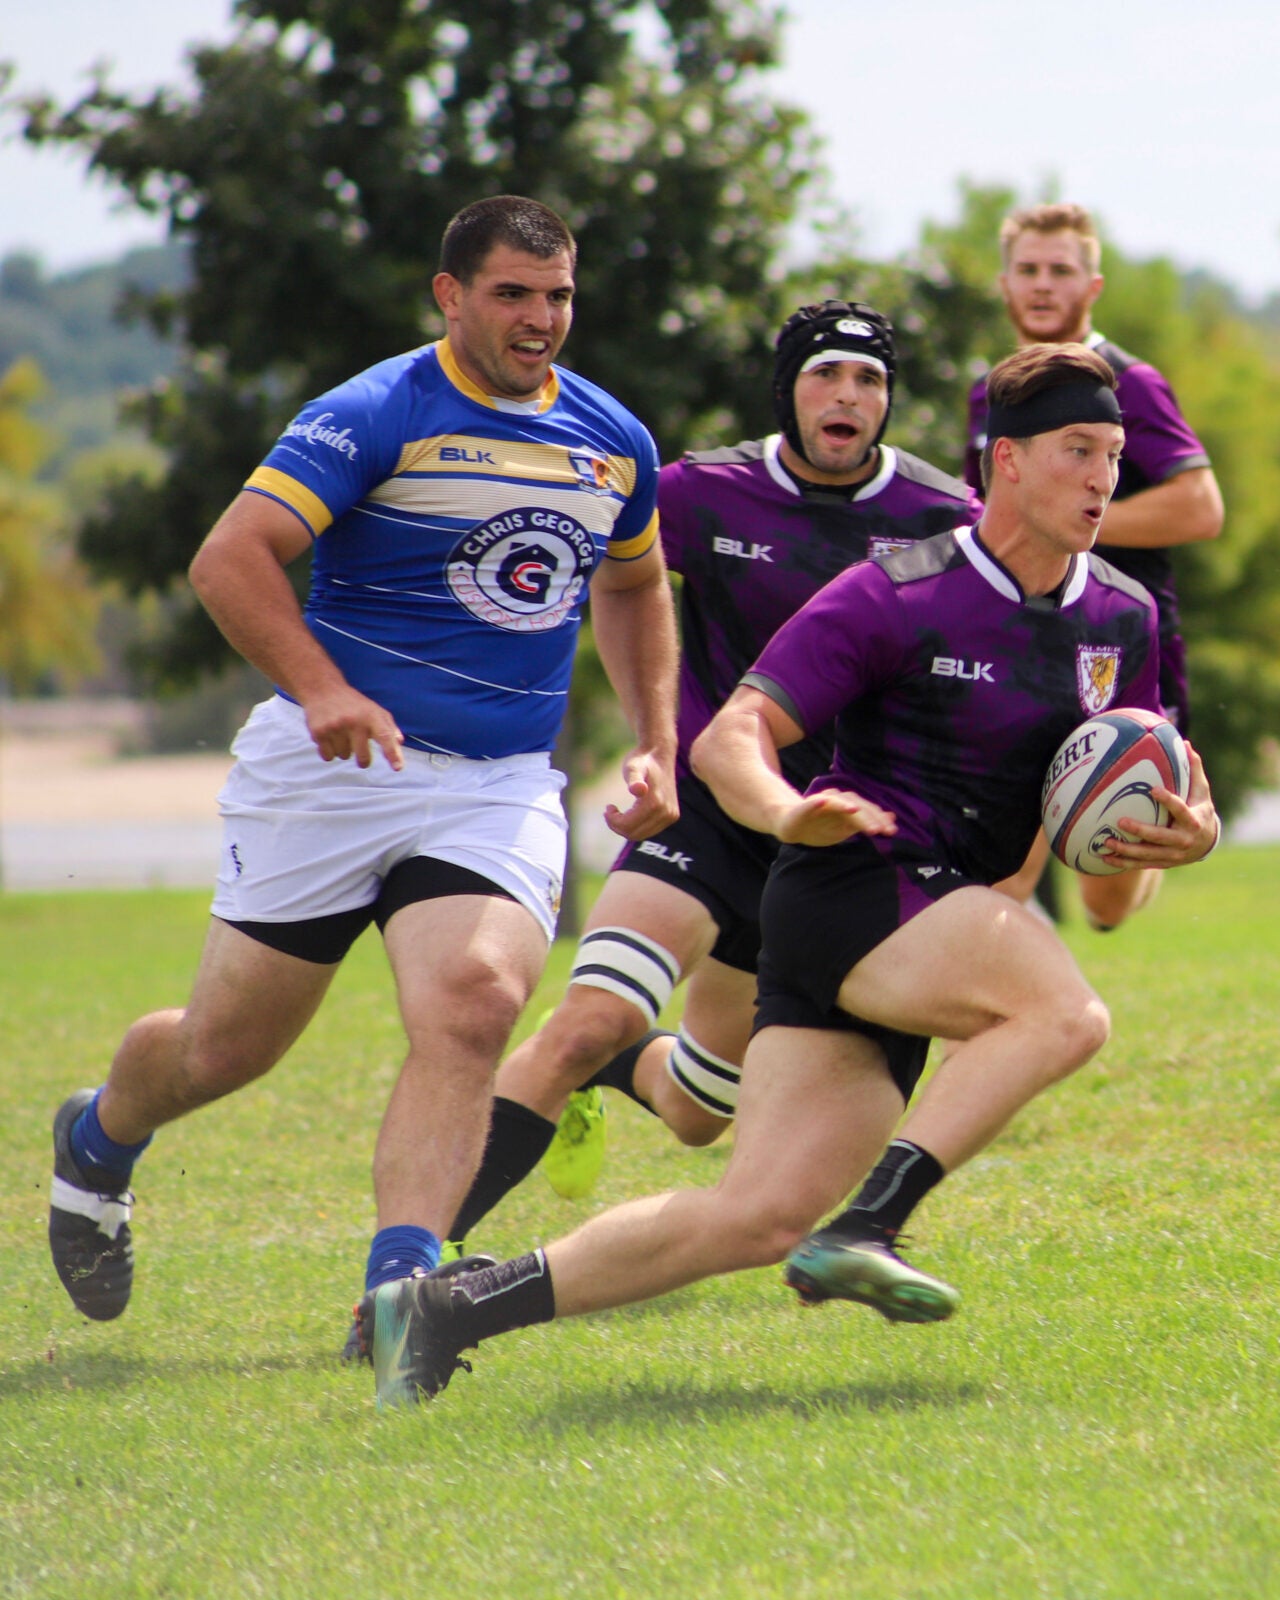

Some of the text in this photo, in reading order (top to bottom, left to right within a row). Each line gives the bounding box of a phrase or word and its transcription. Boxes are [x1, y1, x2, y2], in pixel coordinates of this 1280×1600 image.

[439, 447, 496, 465] BLK
[463, 512, 593, 567] CHRIS GEORGE
[713, 536, 774, 562] BLK
[931, 656, 995, 683] BLK
[636, 840, 694, 871] BLK
